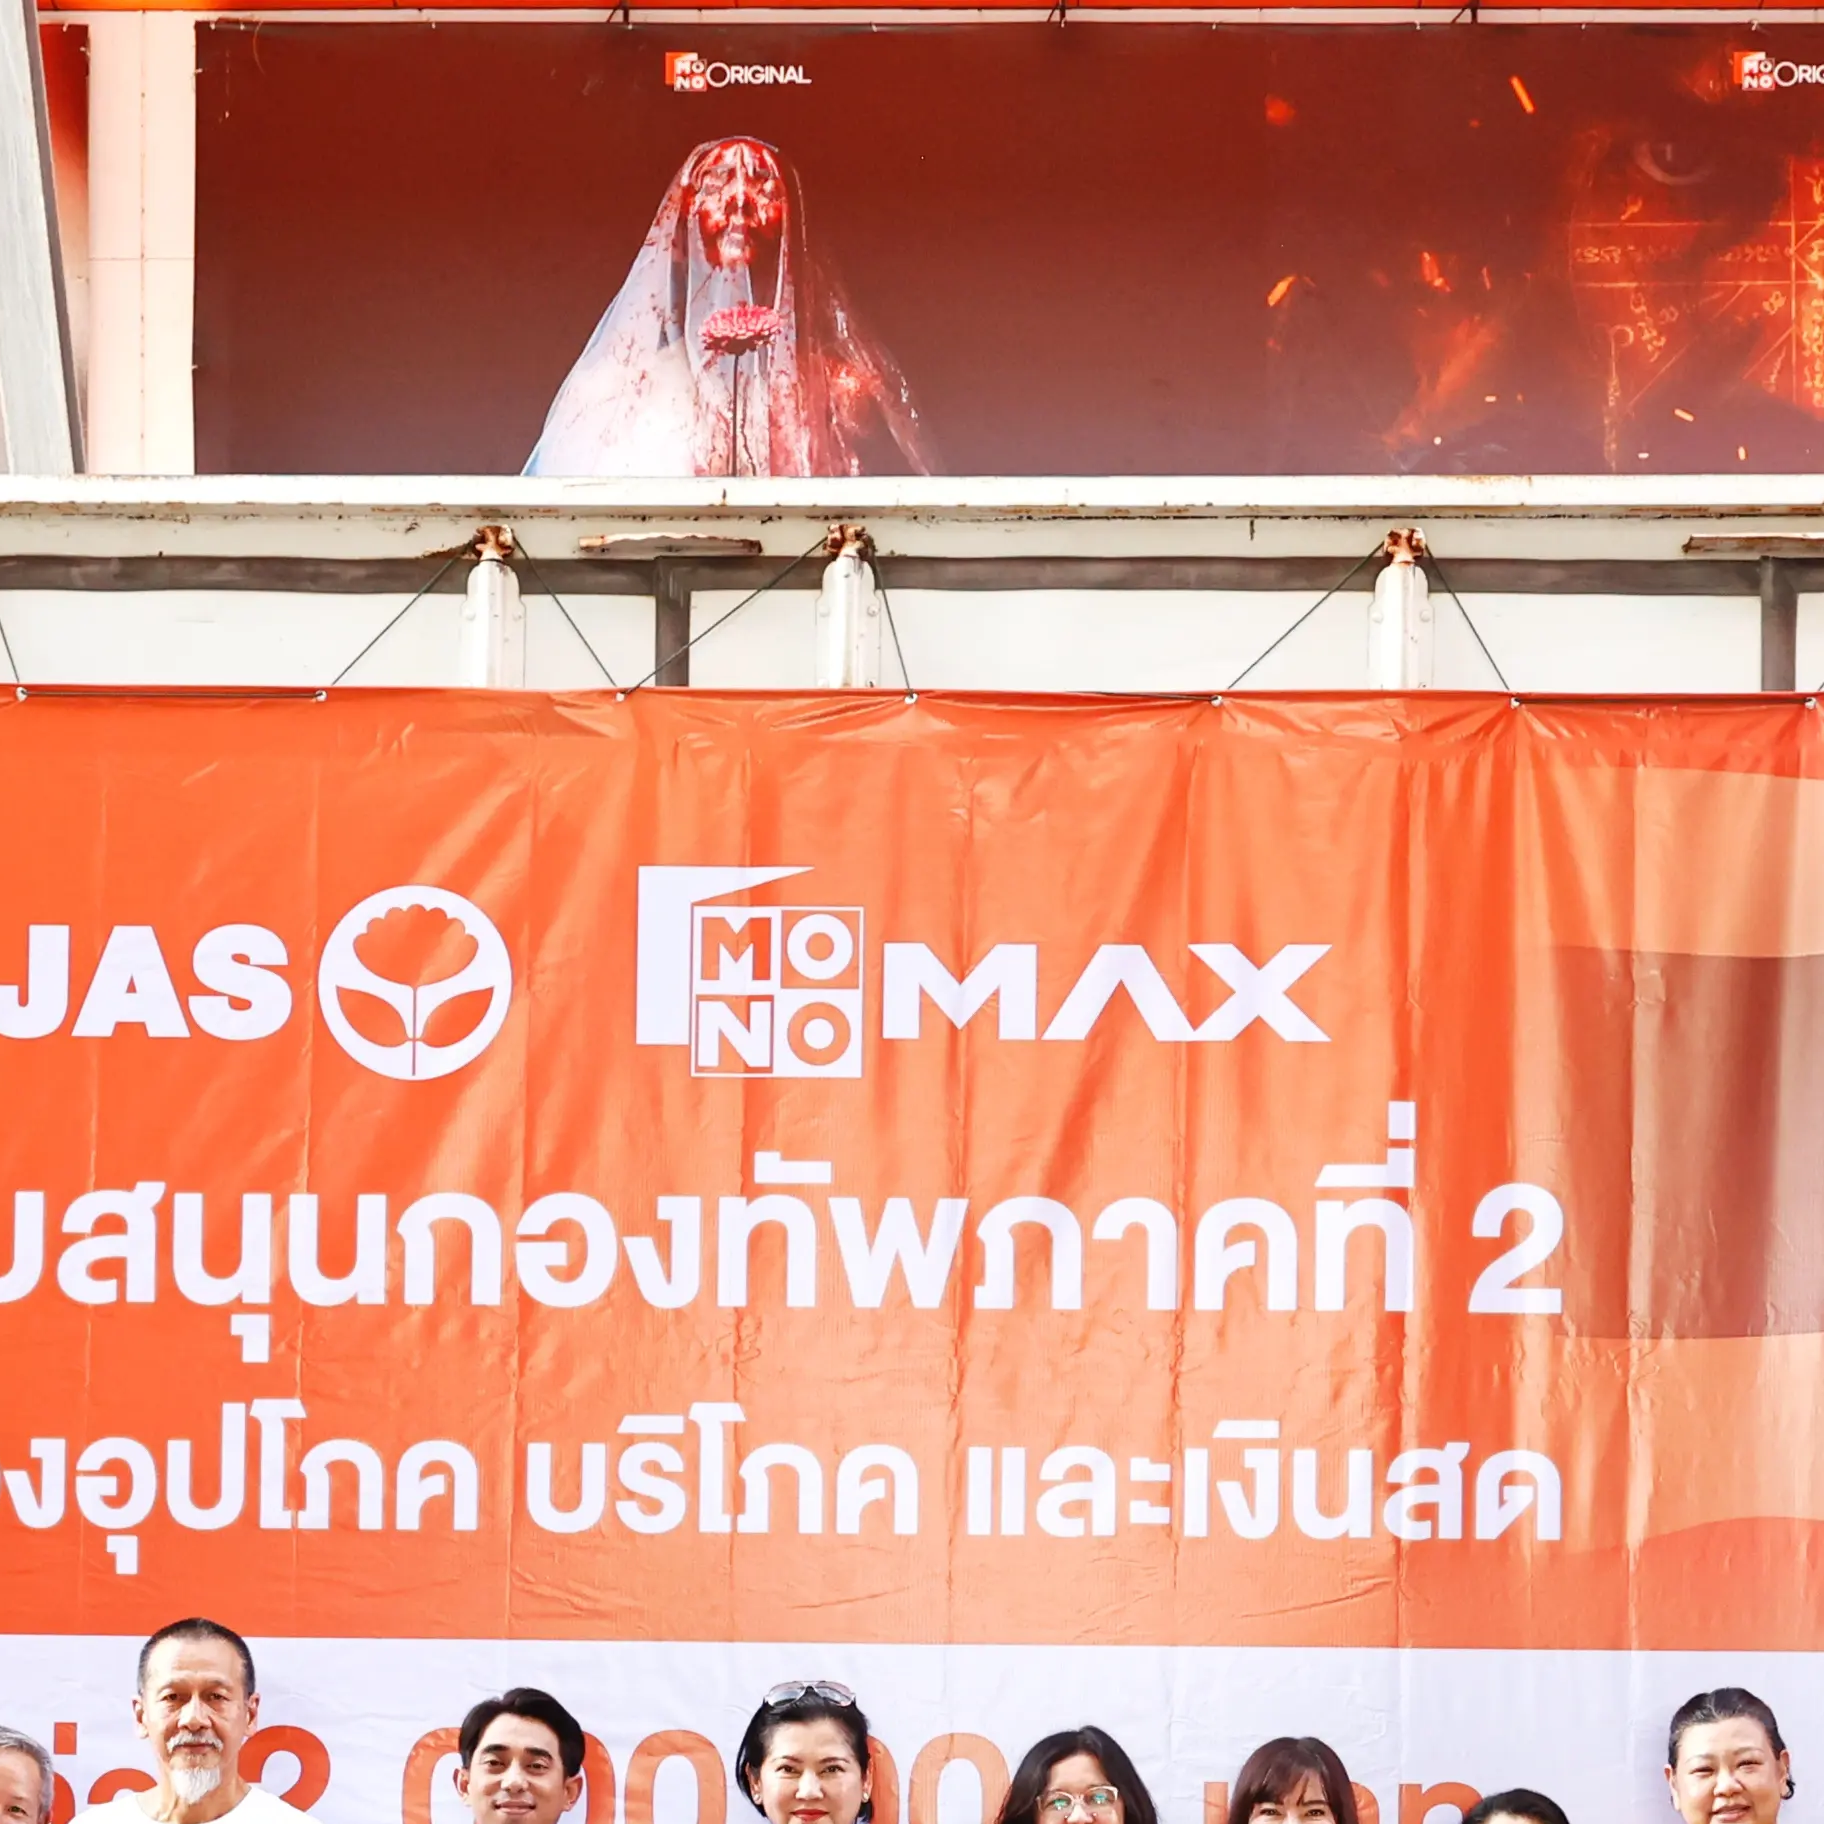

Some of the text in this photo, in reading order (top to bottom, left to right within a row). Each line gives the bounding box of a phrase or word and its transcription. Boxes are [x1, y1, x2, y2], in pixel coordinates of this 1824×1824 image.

[707, 62, 812, 88] ORIGINAL
[1467, 1183, 1565, 1314] 2
[525, 1402, 919, 1535] บริโภค
[967, 1420, 1563, 1541] และเงินสด
